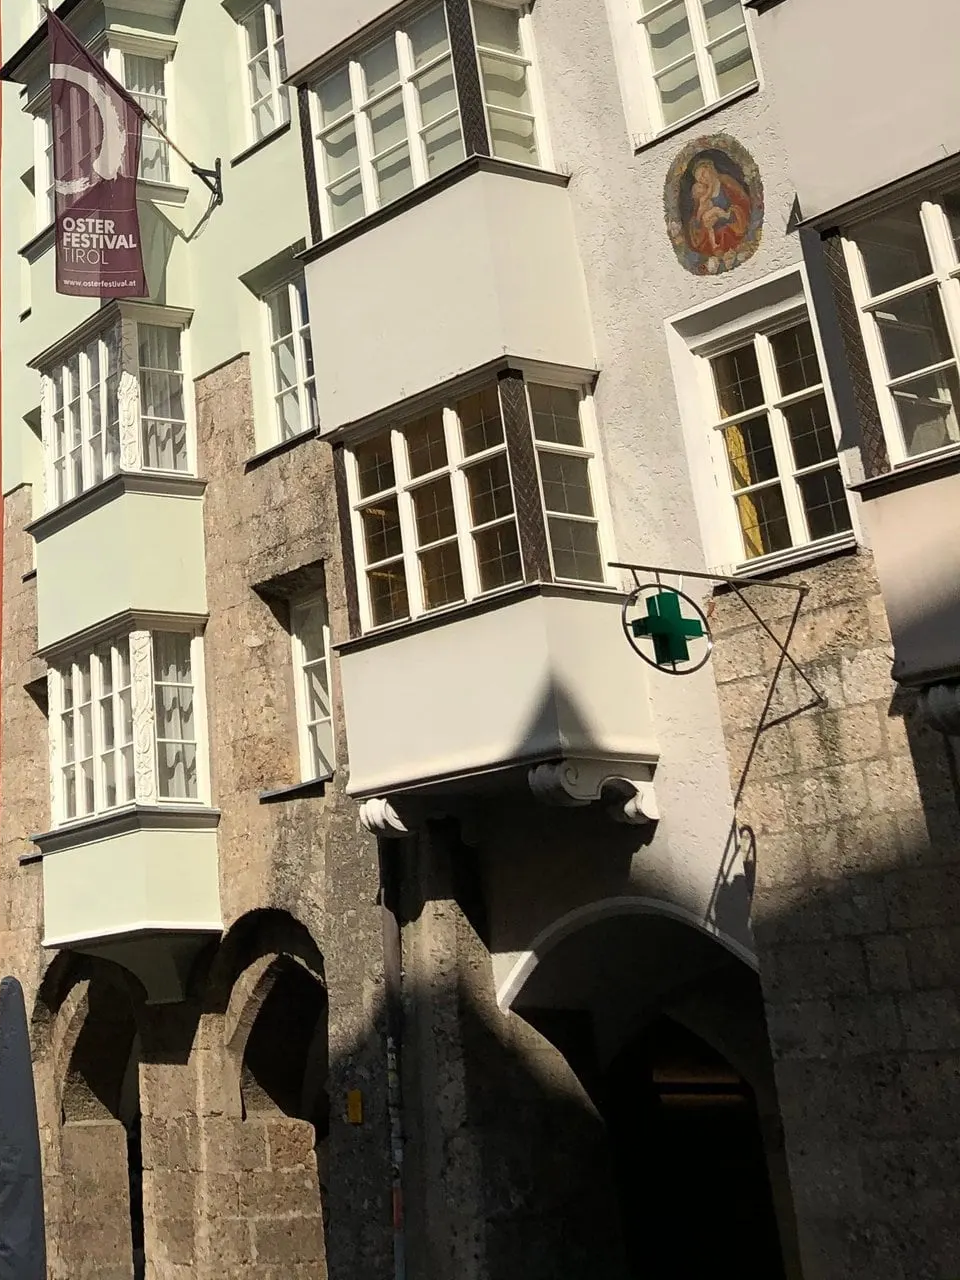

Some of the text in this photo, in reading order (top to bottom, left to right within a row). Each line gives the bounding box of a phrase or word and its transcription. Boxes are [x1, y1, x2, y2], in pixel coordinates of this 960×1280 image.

[63, 217, 115, 233] OSTER
[63, 231, 137, 250] FESTIVAL
[63, 247, 109, 265] TIROL
